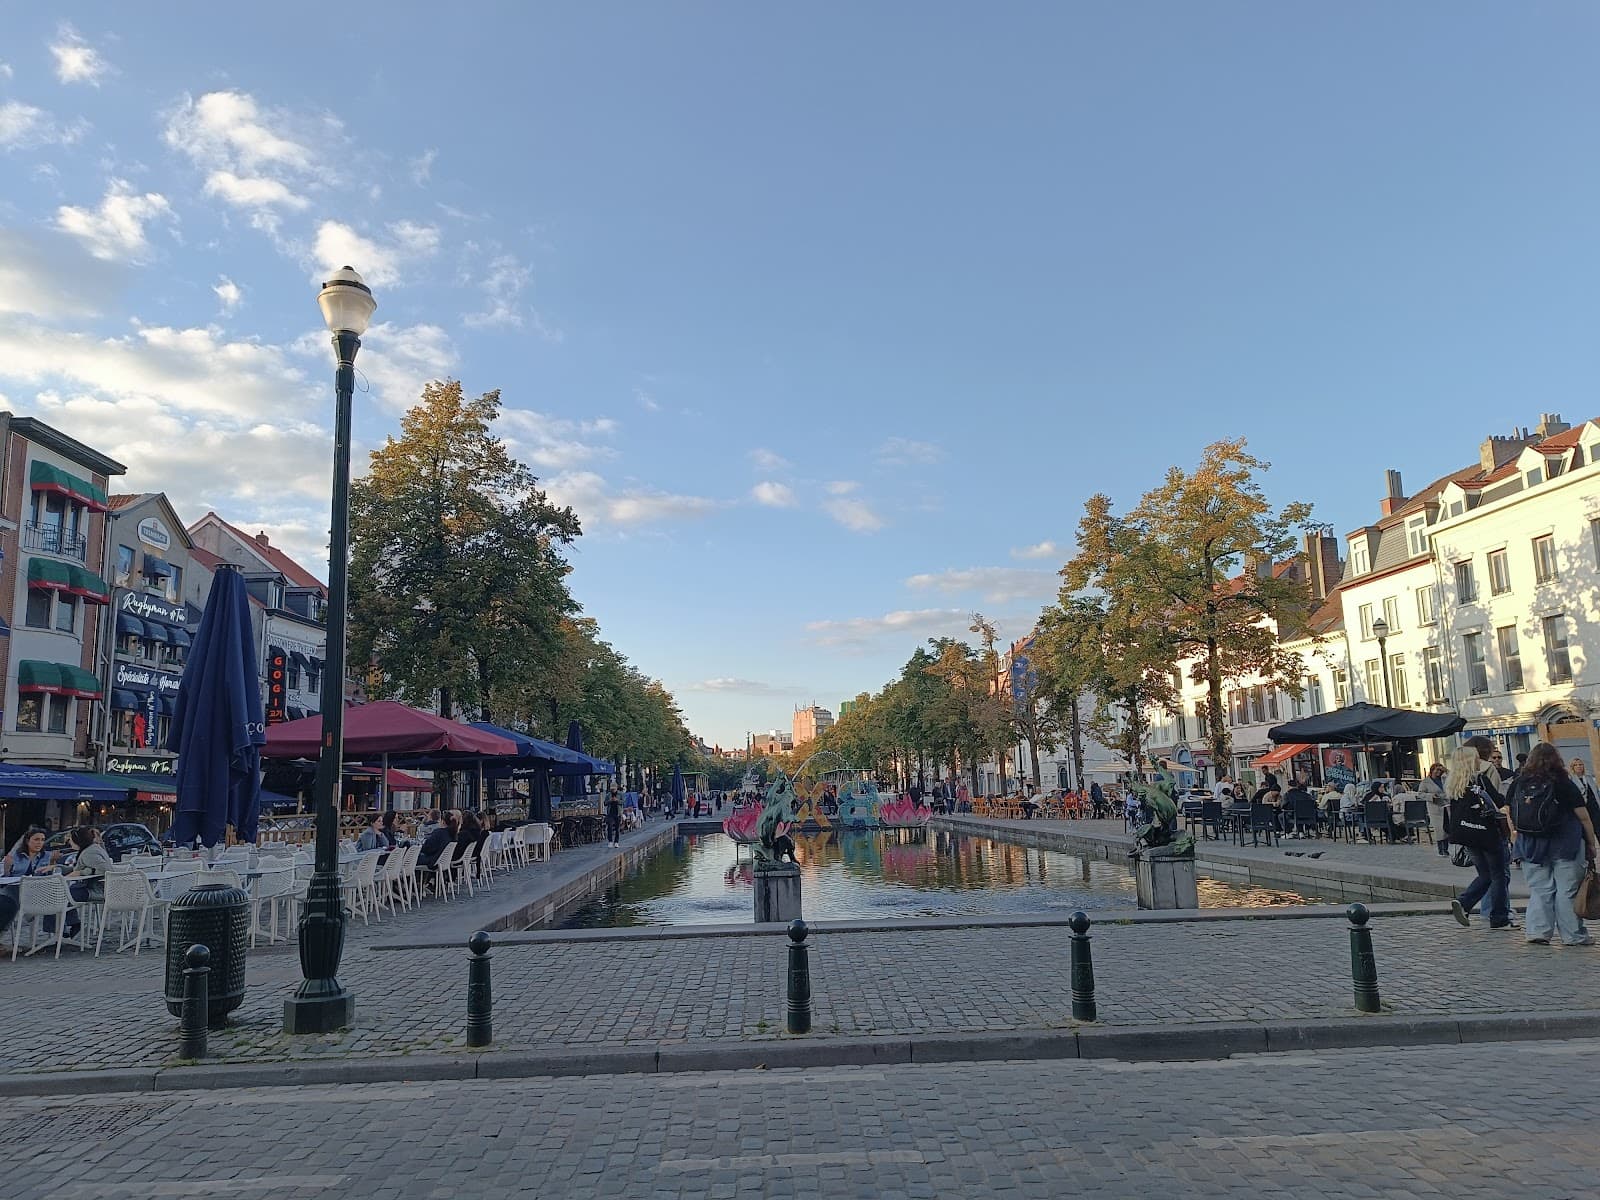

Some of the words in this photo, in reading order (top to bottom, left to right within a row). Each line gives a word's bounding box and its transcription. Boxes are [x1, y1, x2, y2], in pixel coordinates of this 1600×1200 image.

[123, 592, 168, 617] Rugbyman
[272, 656, 283, 707] GOGI
[107, 759, 147, 774] Rugbyman
